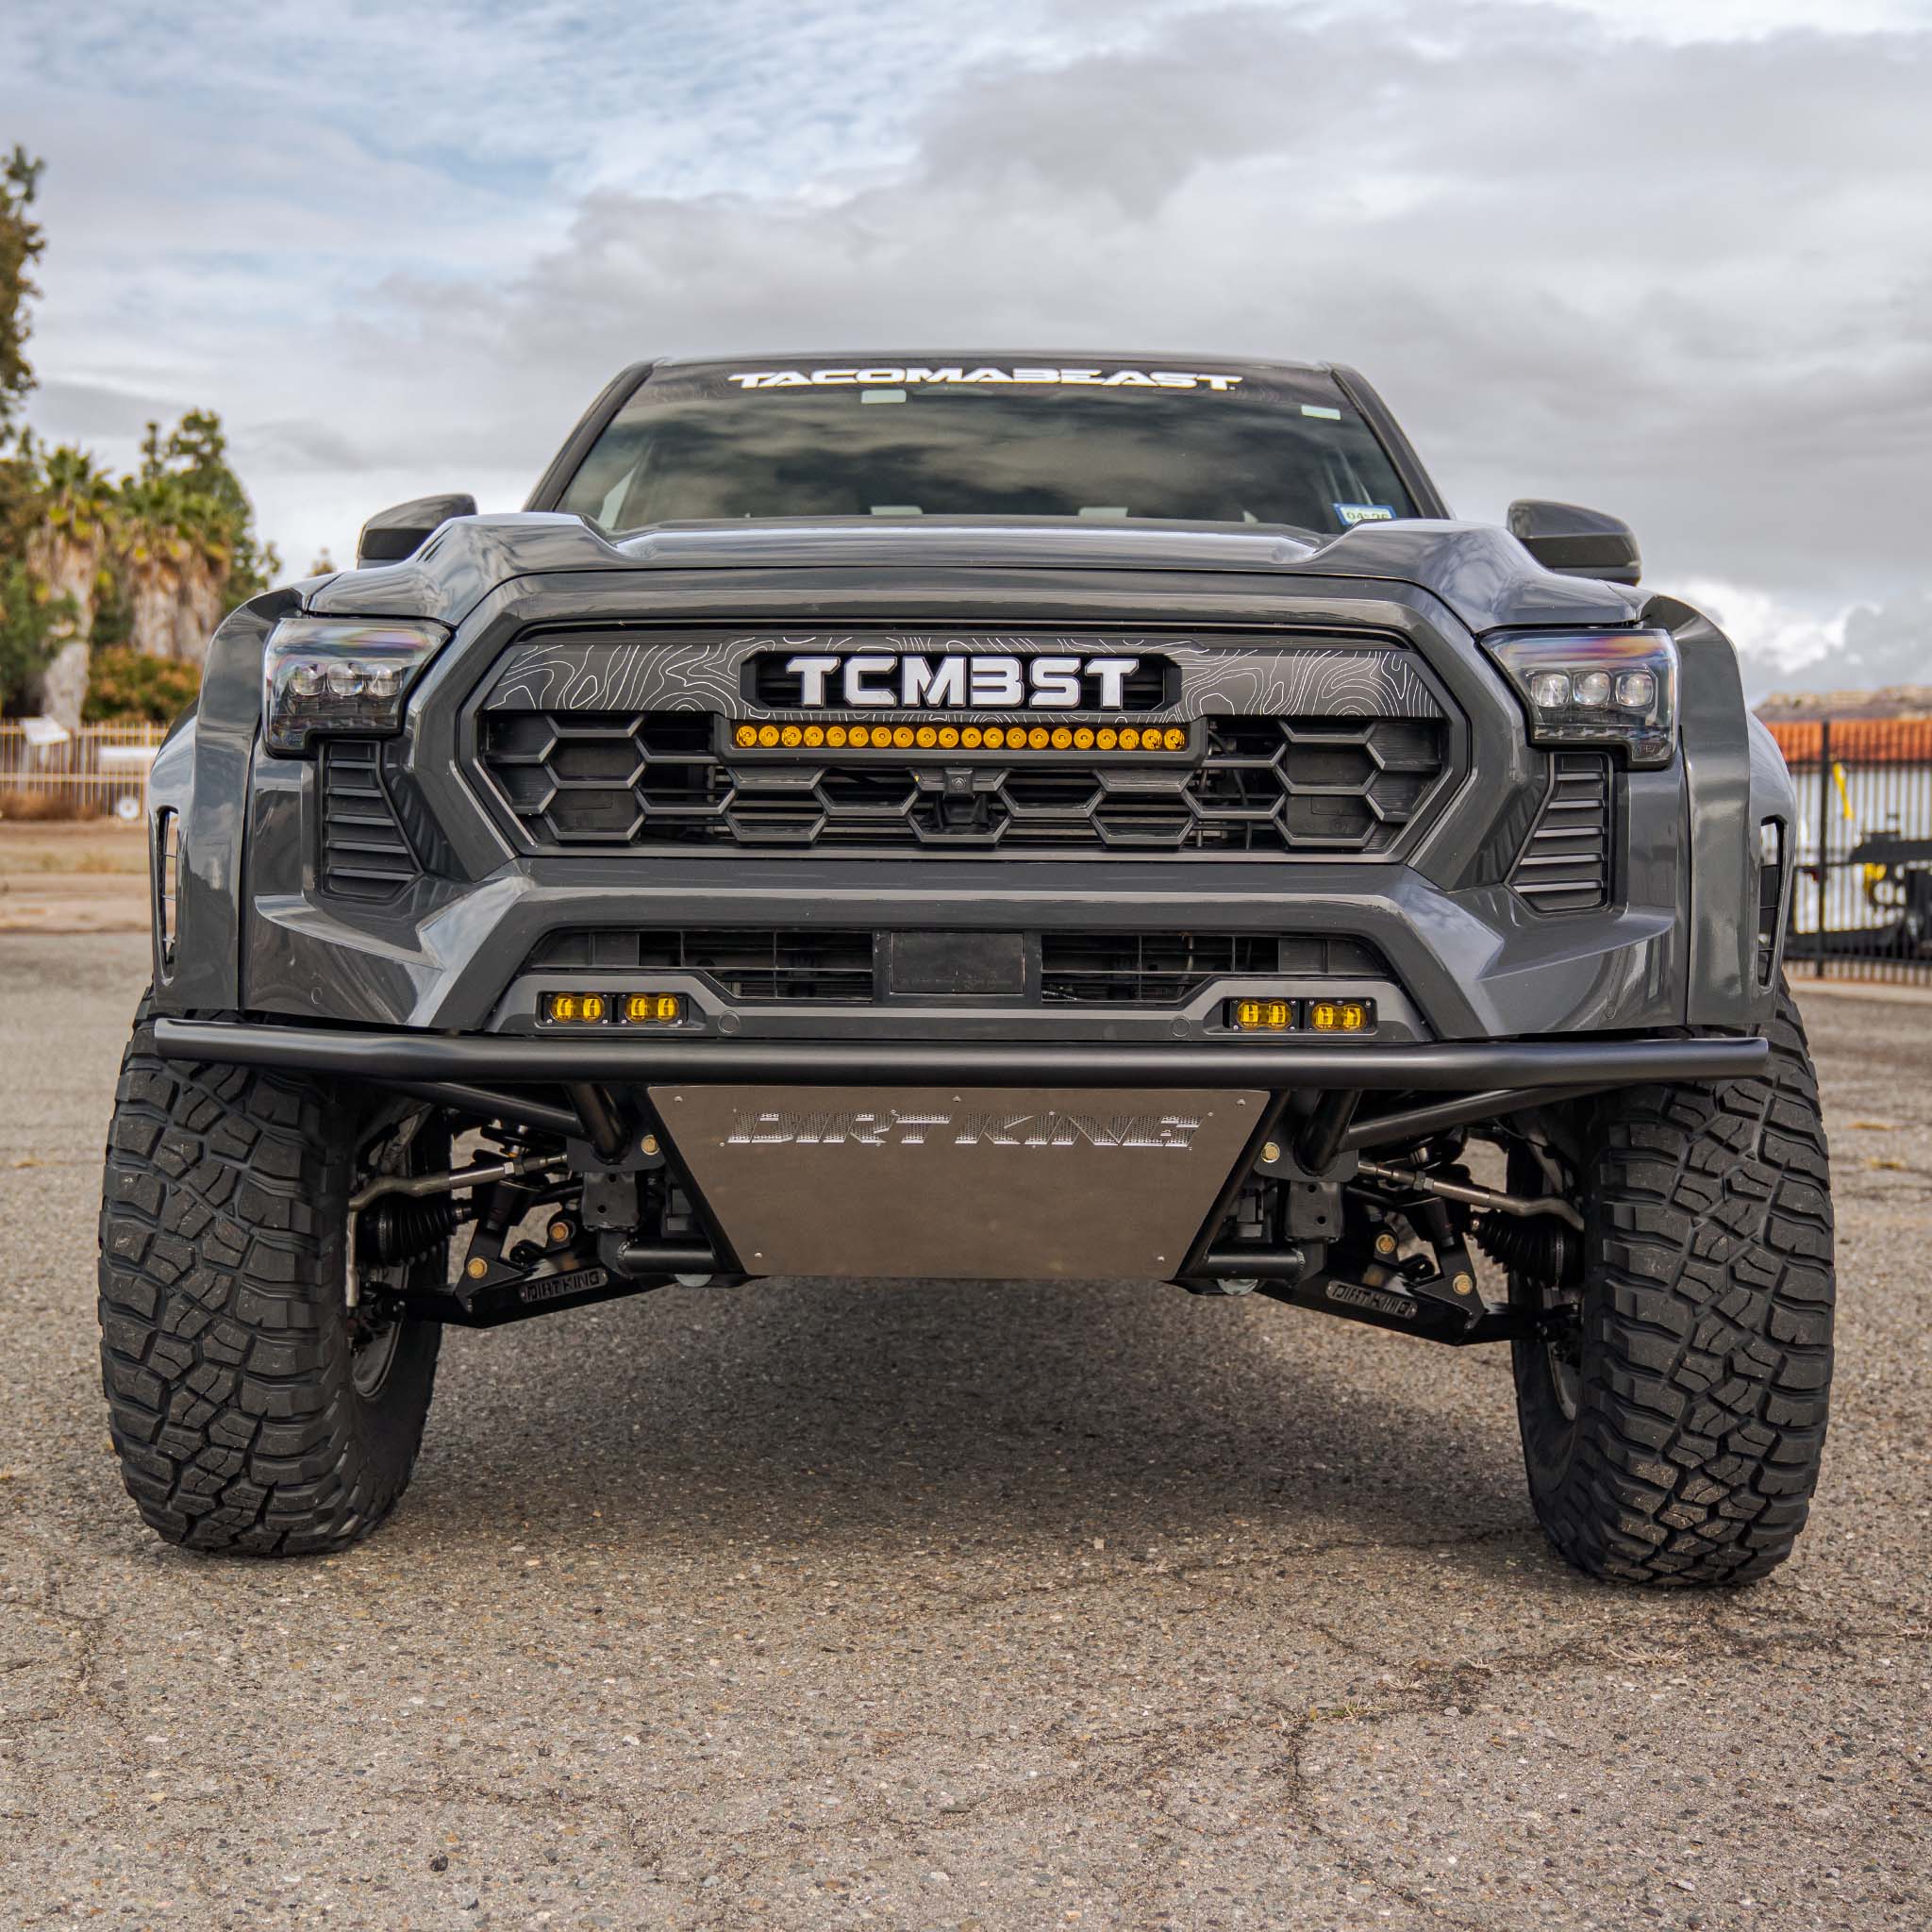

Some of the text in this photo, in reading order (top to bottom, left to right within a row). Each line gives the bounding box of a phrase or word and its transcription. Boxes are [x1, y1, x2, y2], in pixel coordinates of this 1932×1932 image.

[727, 368, 1242, 391] TACOMABEAST
[787, 656, 1139, 709] TCMBST
[727, 1111, 1206, 1147] DIRT KING
[561, 1270, 600, 1292] KING
